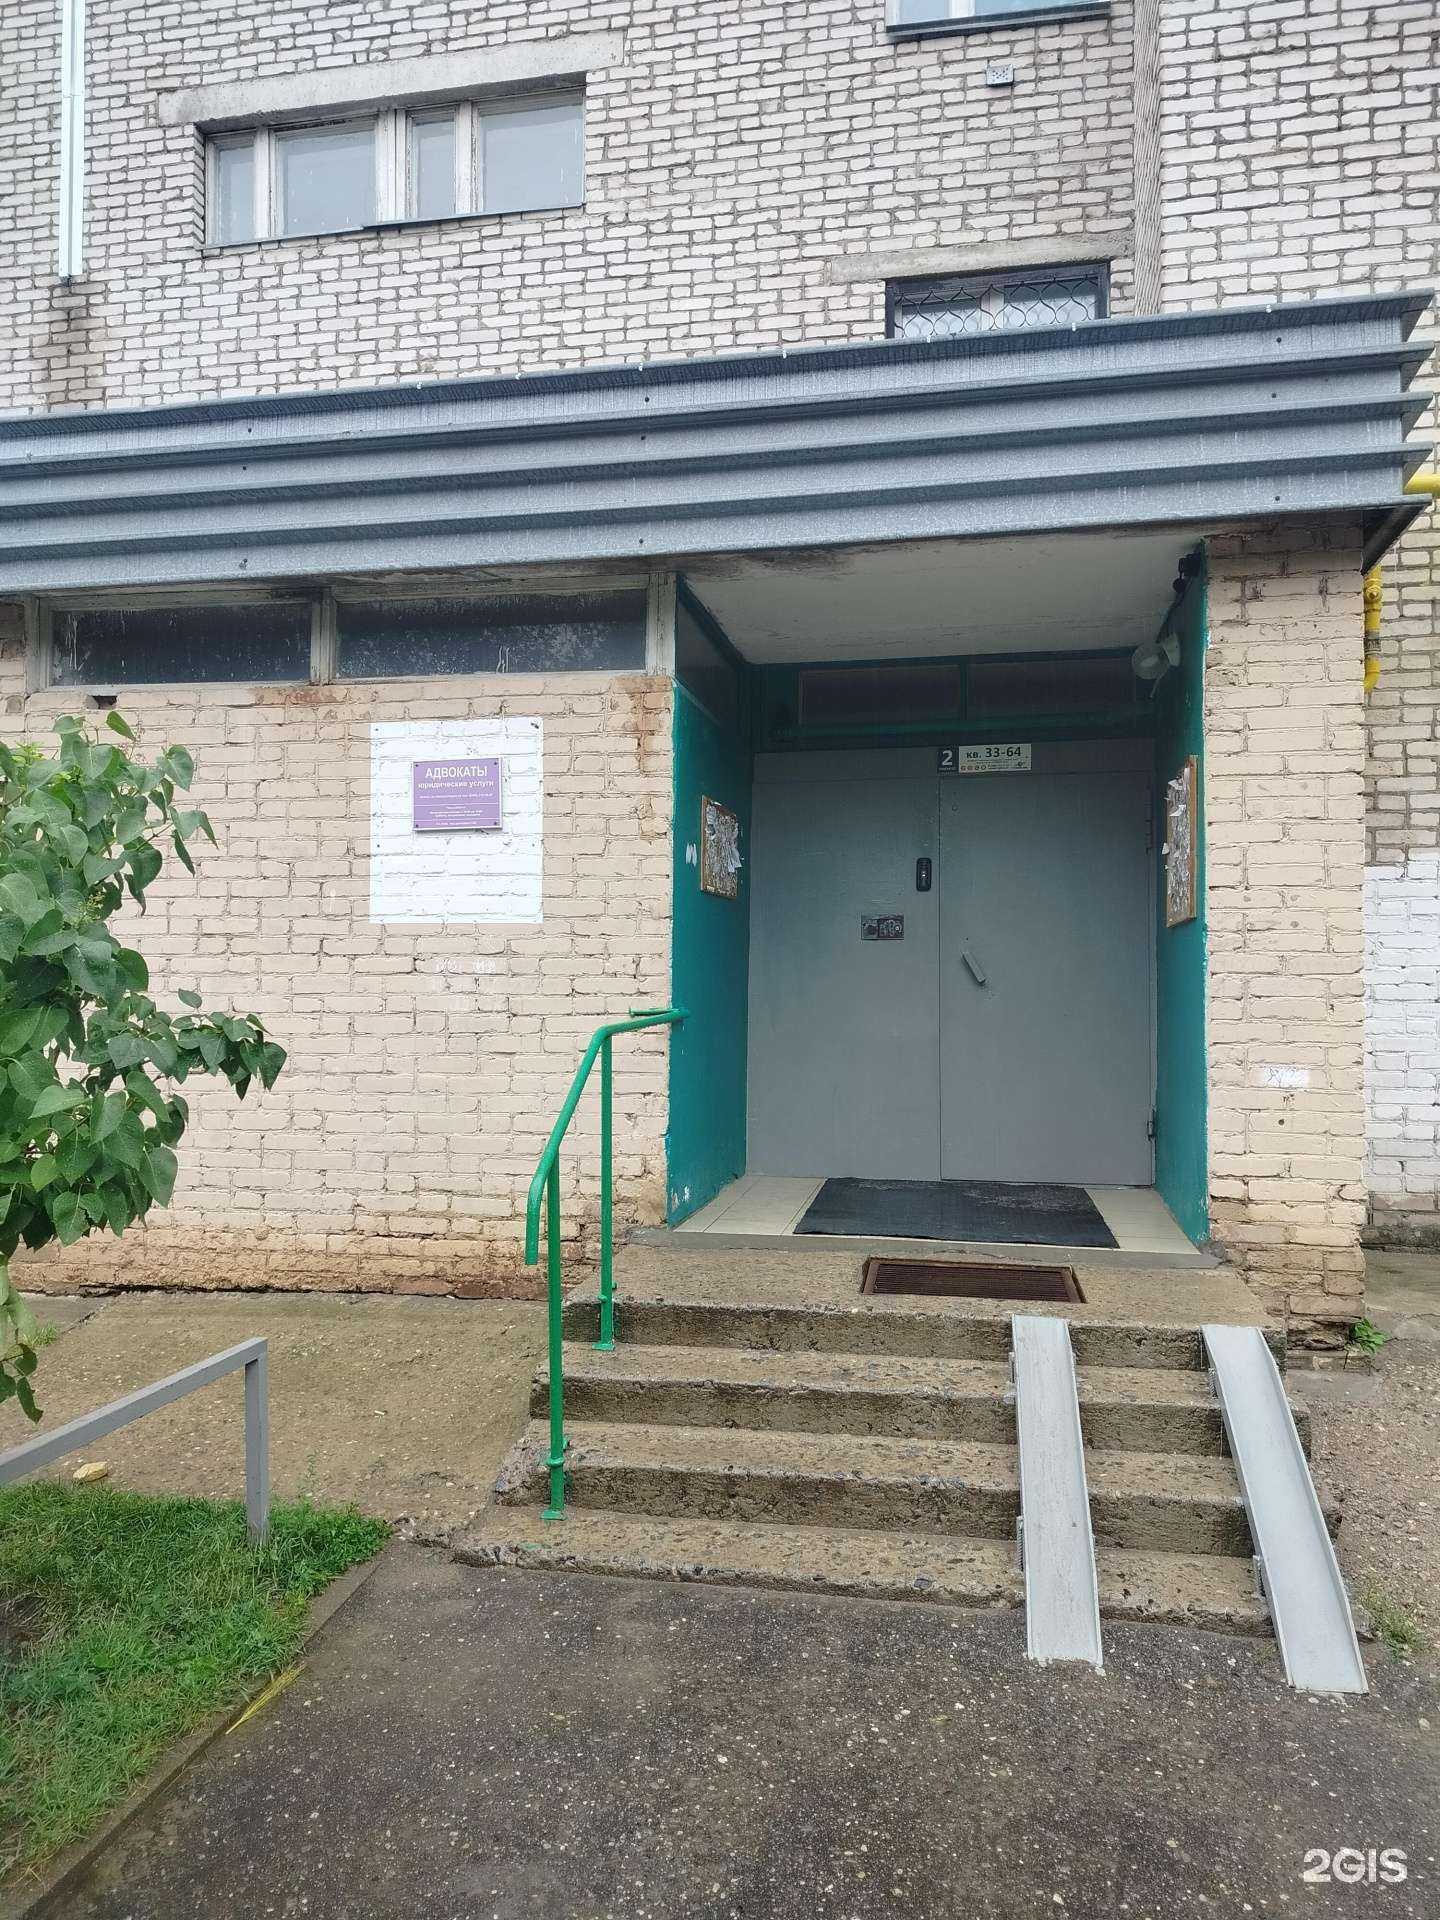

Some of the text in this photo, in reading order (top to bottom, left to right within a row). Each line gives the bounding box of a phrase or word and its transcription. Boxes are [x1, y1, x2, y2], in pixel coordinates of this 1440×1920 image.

[942, 749, 953, 766] 2
[985, 746, 1021, 758] 33-64
[425, 766, 488, 779] АДВОКАТЫ
